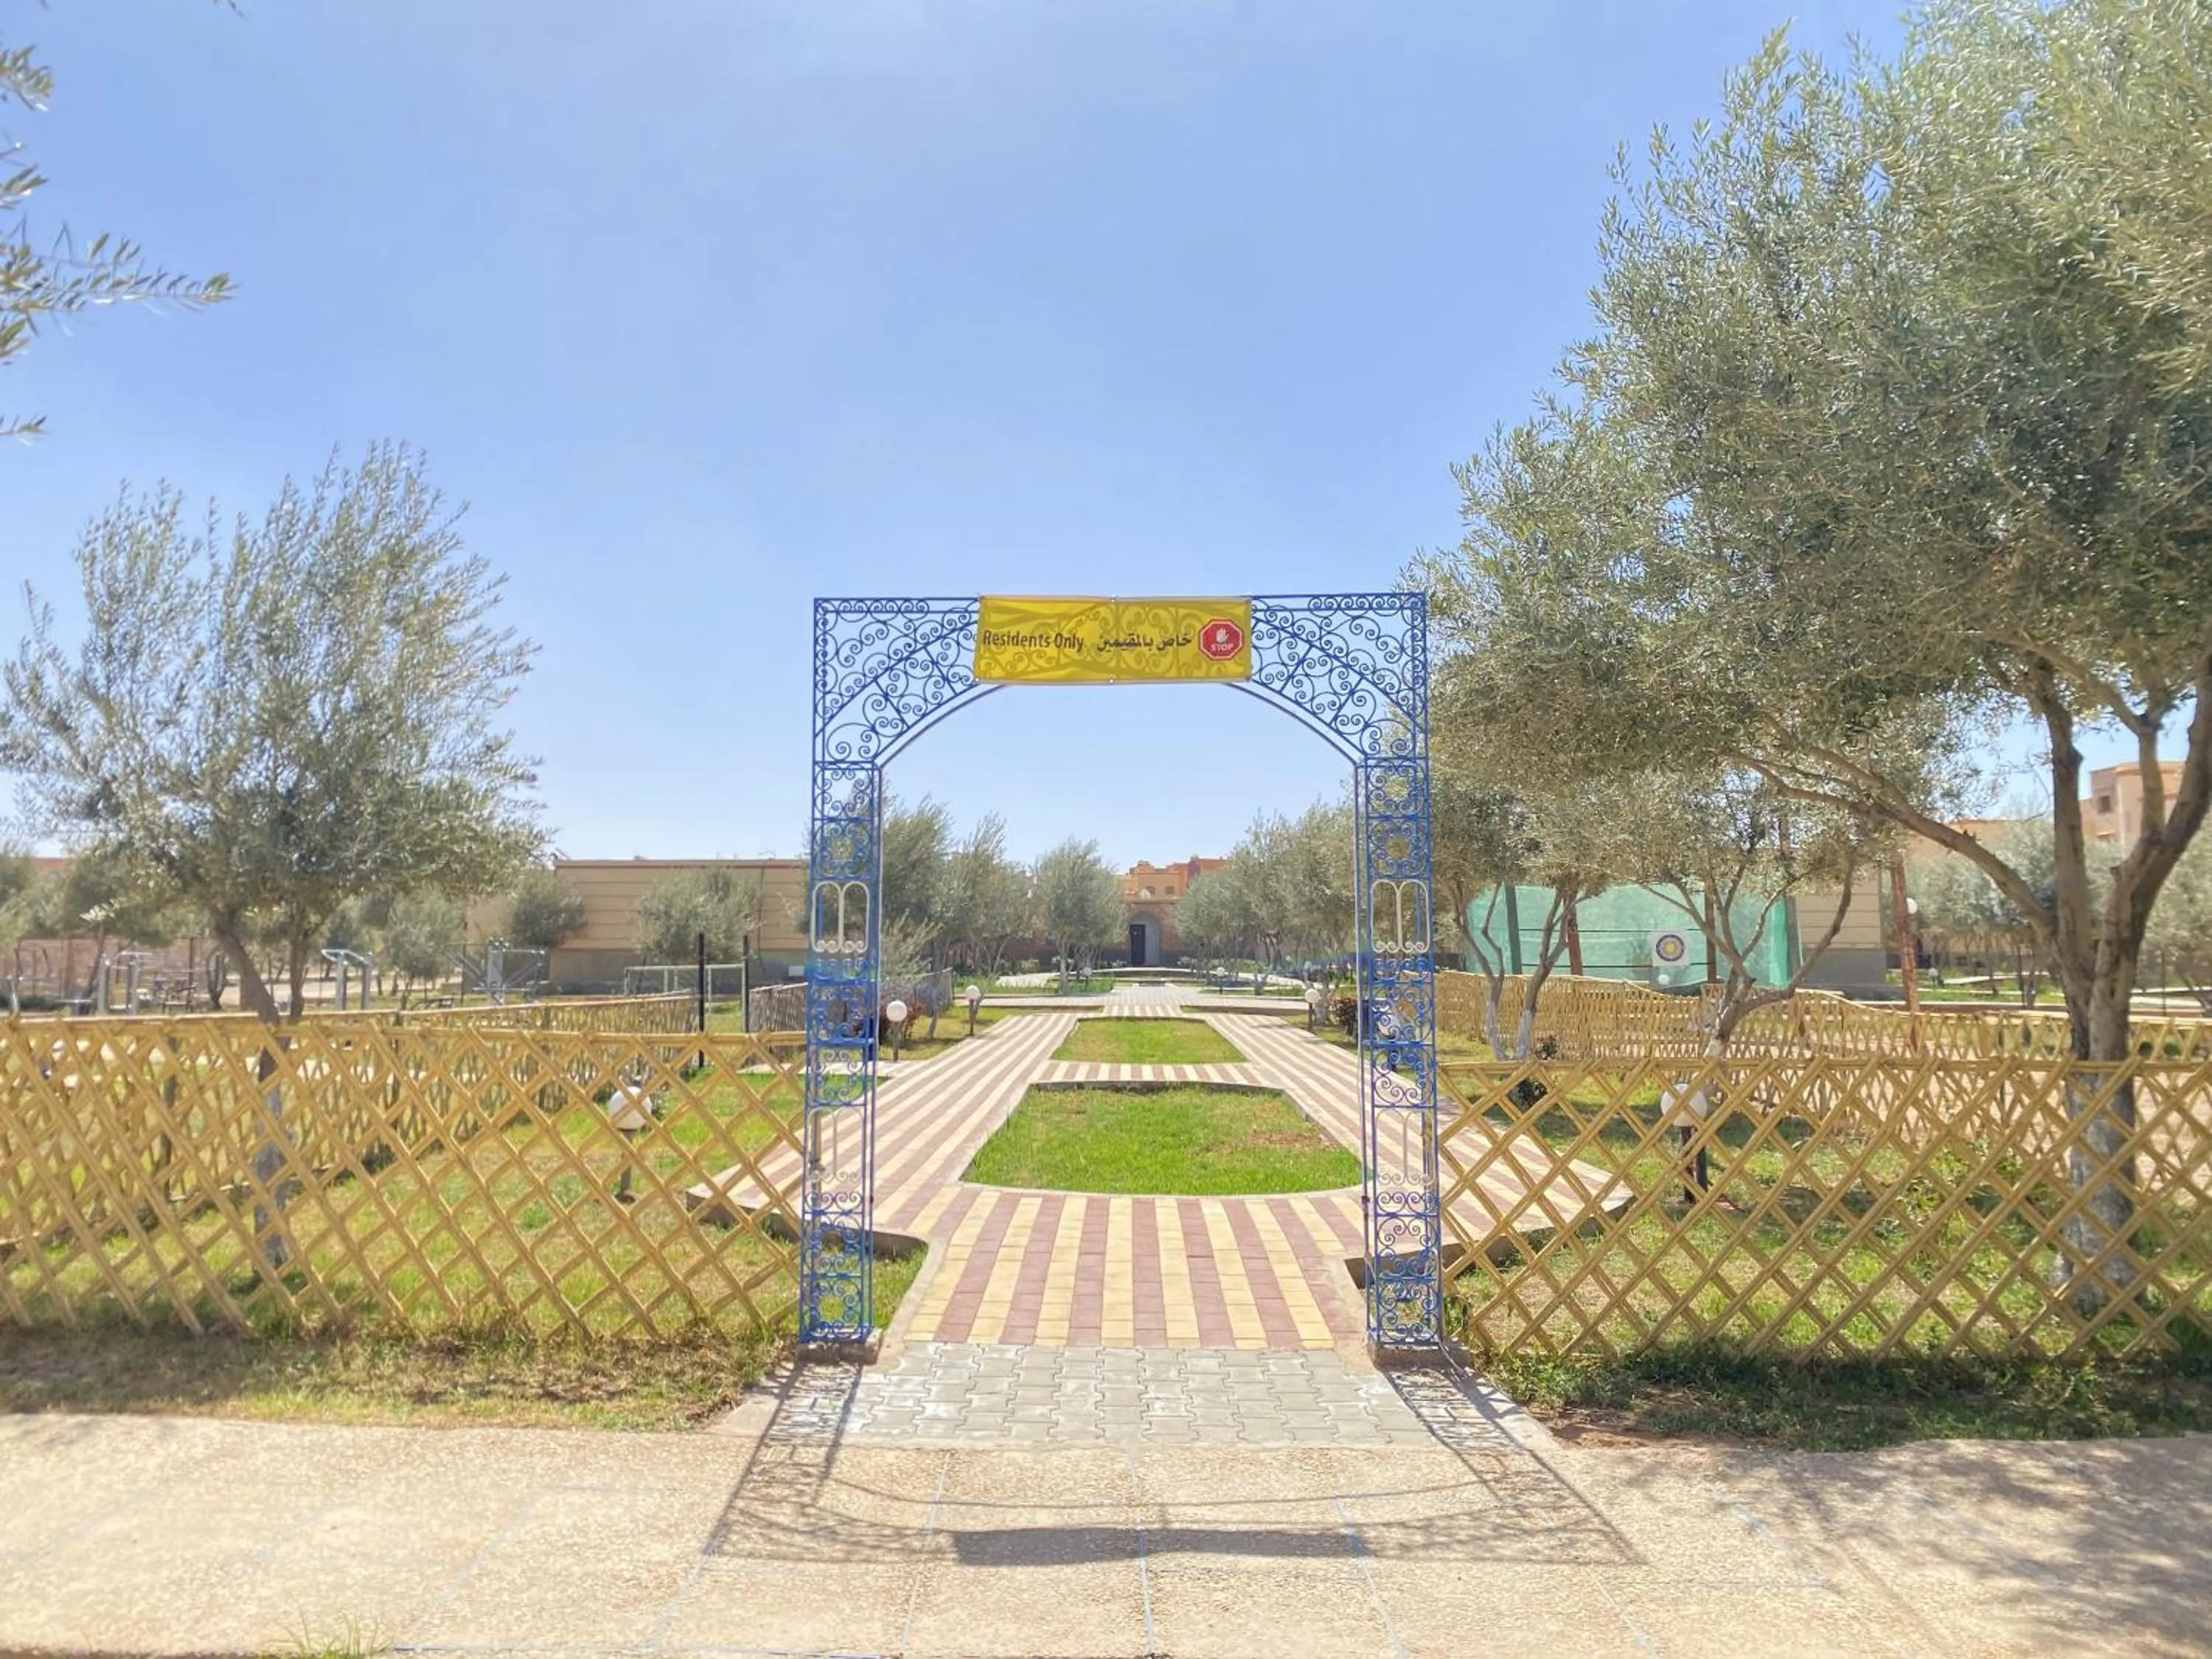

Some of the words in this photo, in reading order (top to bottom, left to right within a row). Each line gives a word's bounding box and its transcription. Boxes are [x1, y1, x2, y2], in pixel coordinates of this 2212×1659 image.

[983, 630, 1051, 649] Residents
[1054, 632, 1085, 653] Only
[1096, 633, 1154, 652] بالمقيمين
[1156, 632, 1192, 651] خاص
[1210, 643, 1234, 652] STOP
